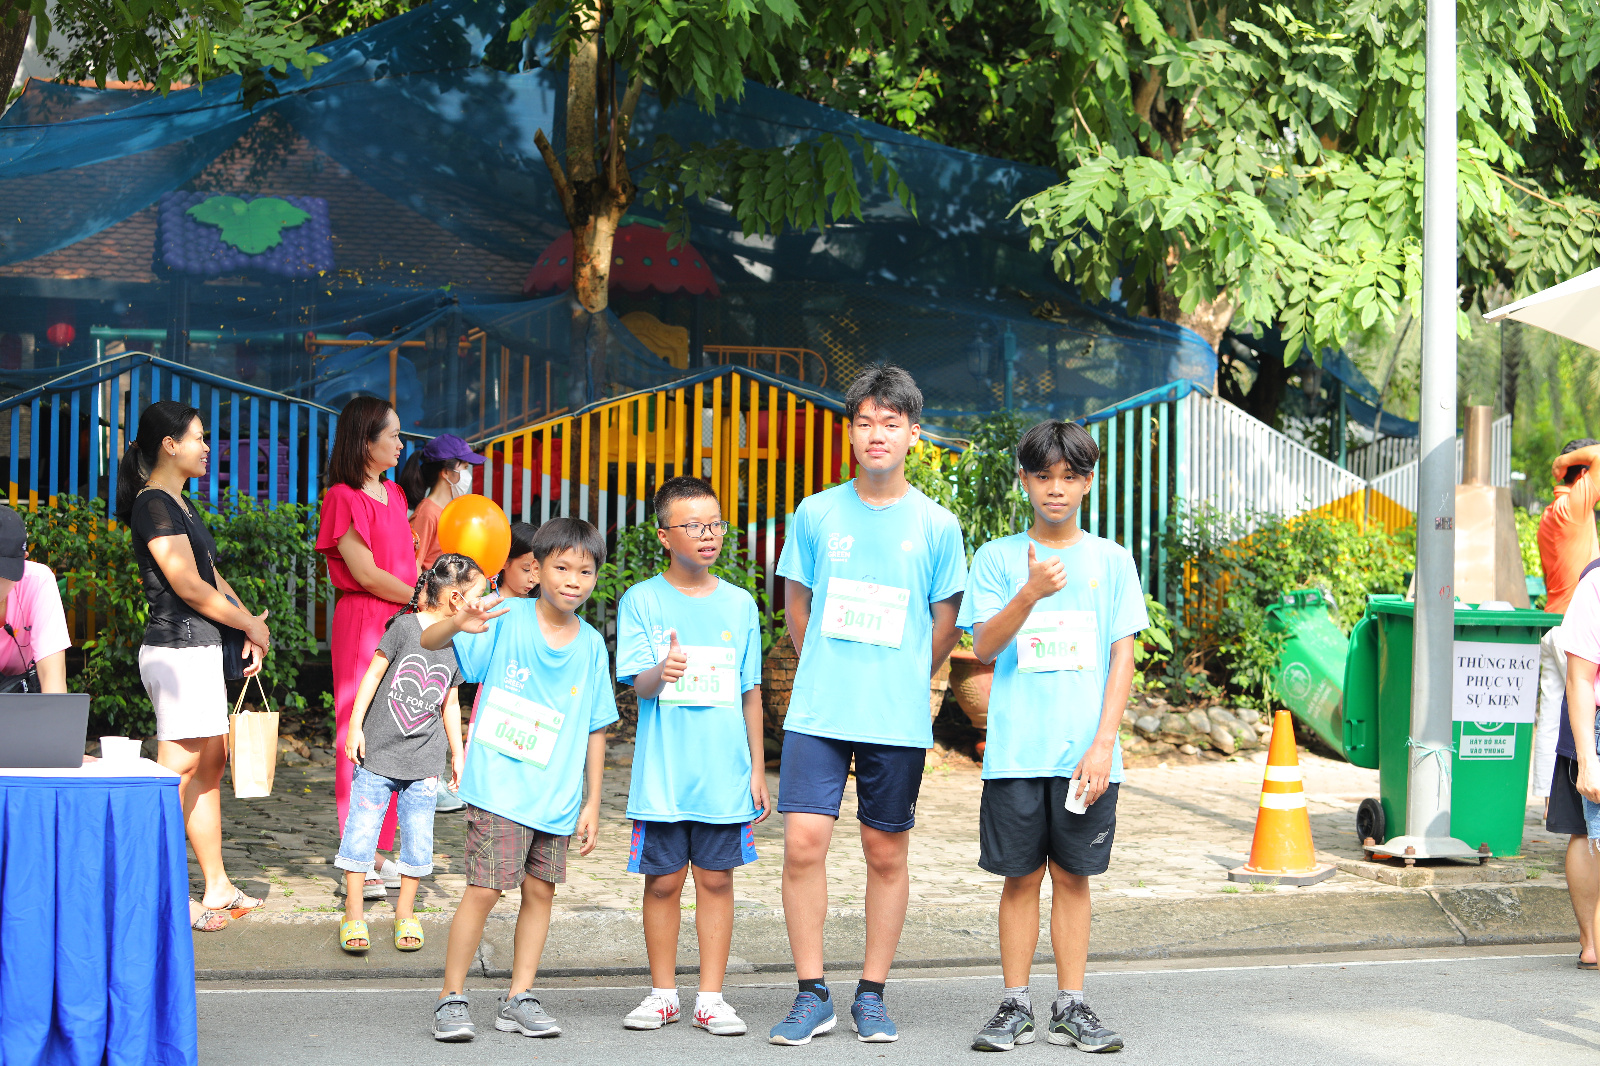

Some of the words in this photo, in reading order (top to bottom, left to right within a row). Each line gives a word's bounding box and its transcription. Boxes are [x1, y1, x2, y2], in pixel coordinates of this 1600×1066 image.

[828, 536, 853, 550] GO
[828, 550, 850, 558] GREEN
[845, 609, 882, 631] 0471
[1457, 654, 1505, 669] THÙNG
[1509, 655, 1534, 670] RÁC
[506, 664, 531, 682] GO
[504, 677, 524, 690] GREEN
[675, 673, 720, 693] 0355
[1466, 676, 1503, 690] PHỤC
[1507, 677, 1523, 690] VỤ
[387, 690, 403, 702] ALL
[406, 696, 424, 708] FOR
[1467, 692, 1486, 708] SỰ
[1488, 693, 1520, 708] KIỆN
[494, 722, 538, 751] 0459
